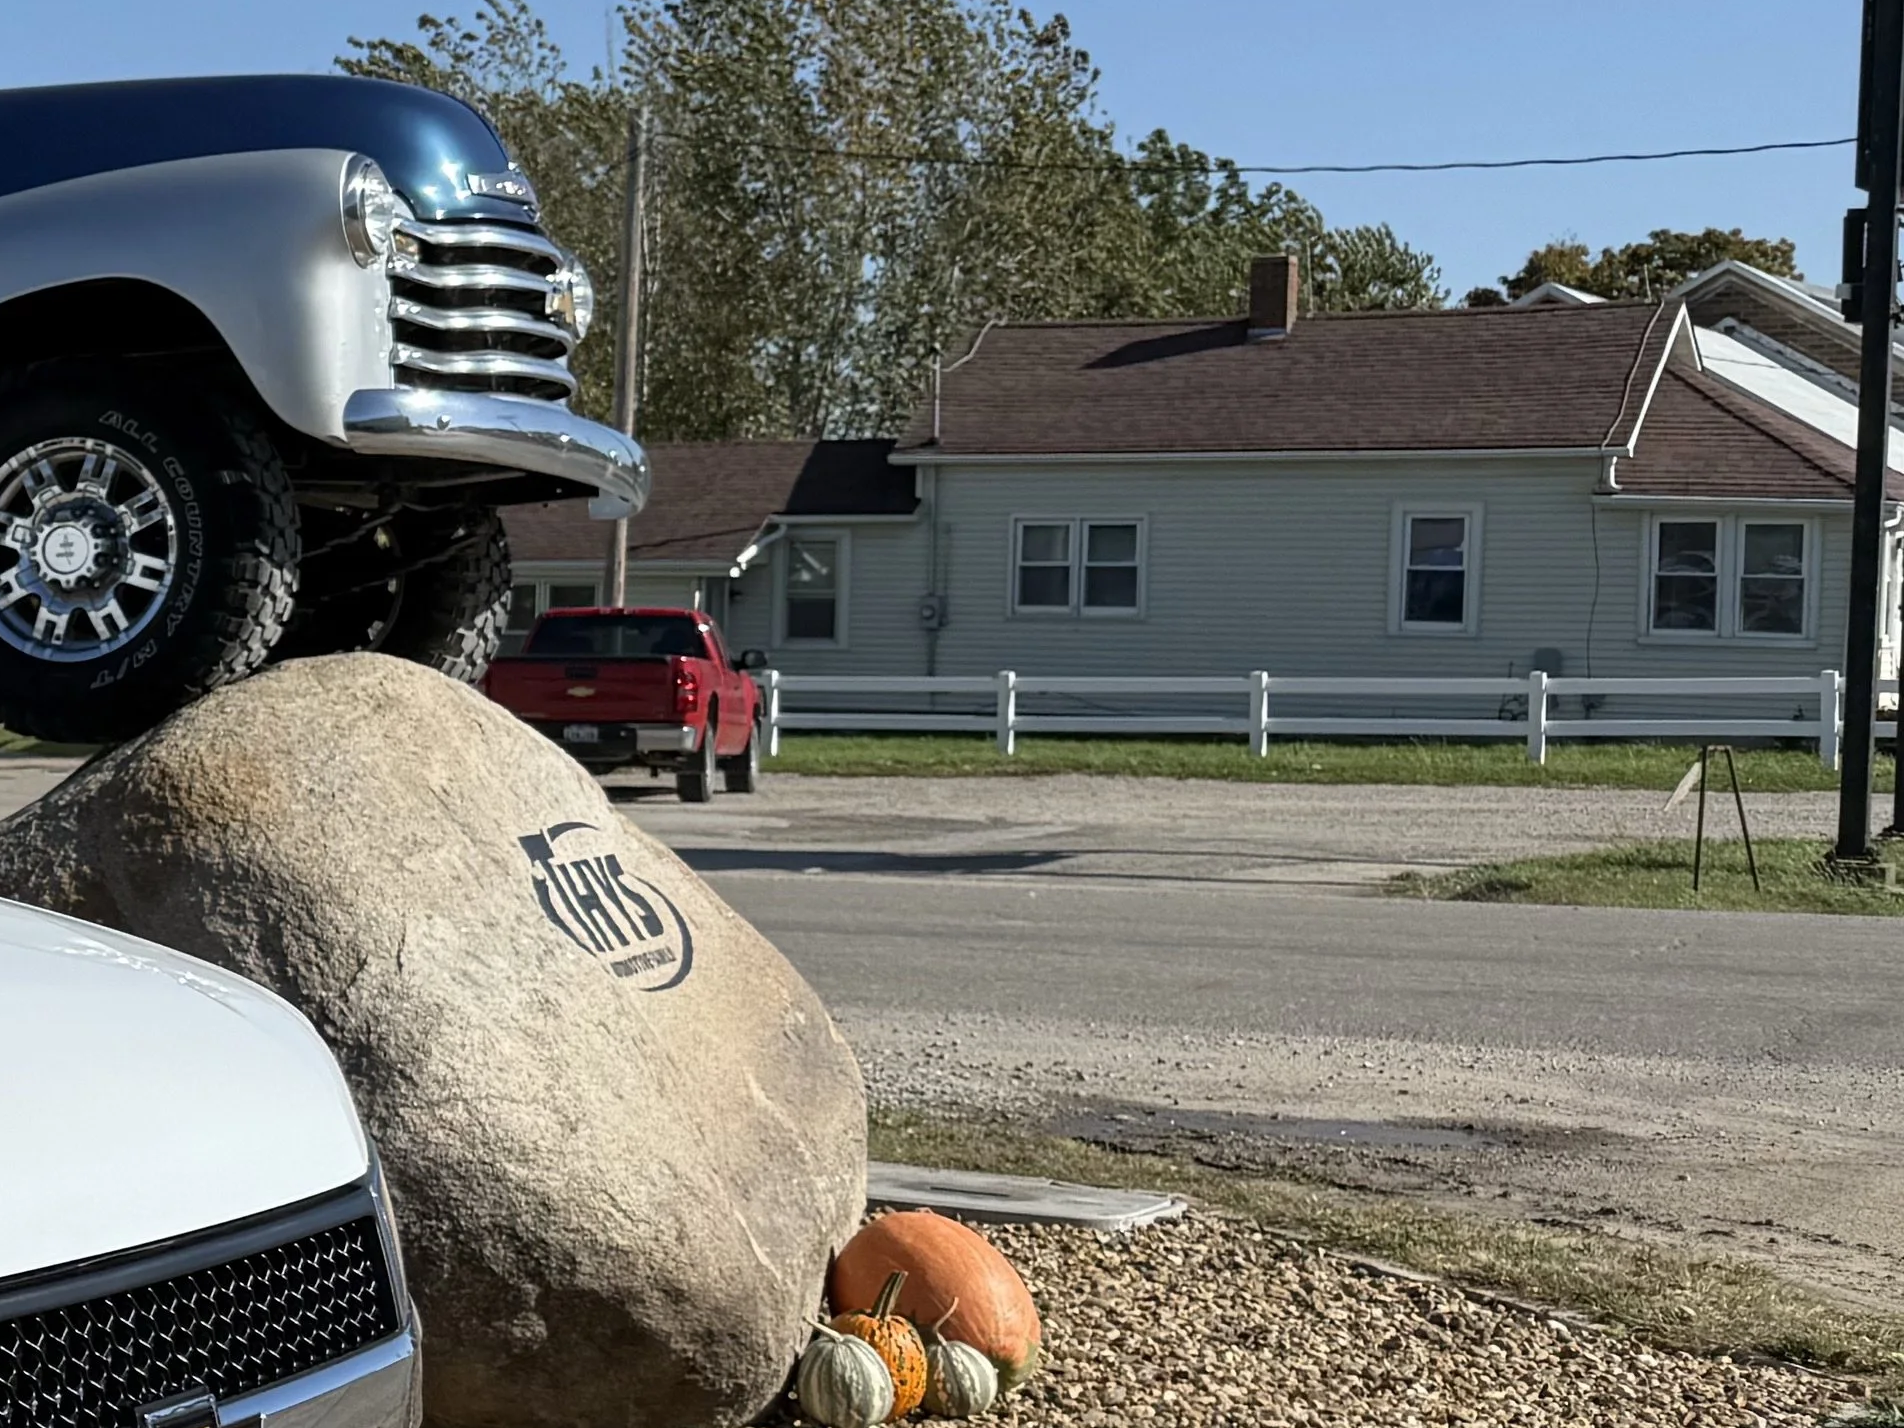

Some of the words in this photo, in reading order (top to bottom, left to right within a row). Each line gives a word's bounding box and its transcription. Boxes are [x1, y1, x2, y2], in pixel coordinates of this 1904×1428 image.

[98, 409, 158, 454] ALL
[163, 456, 204, 637] COUNTRY
[518, 828, 664, 953] THYS
